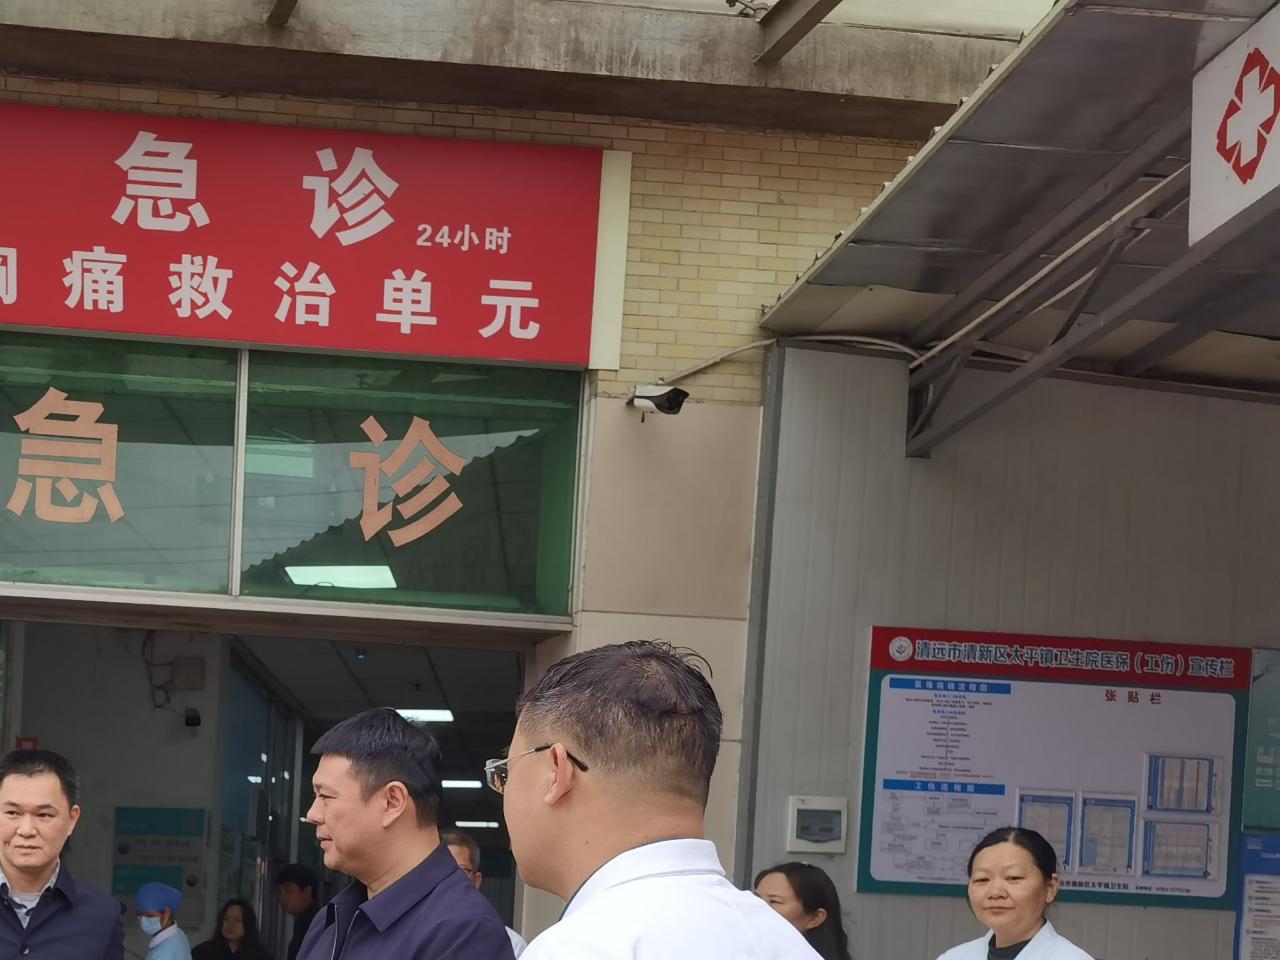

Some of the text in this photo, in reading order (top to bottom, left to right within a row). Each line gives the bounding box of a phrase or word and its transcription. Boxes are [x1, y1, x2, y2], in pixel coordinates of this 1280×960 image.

[111, 130, 400, 246] 急诊
[415, 223, 512, 255] 24小时
[6, 386, 468, 548] 急诊
